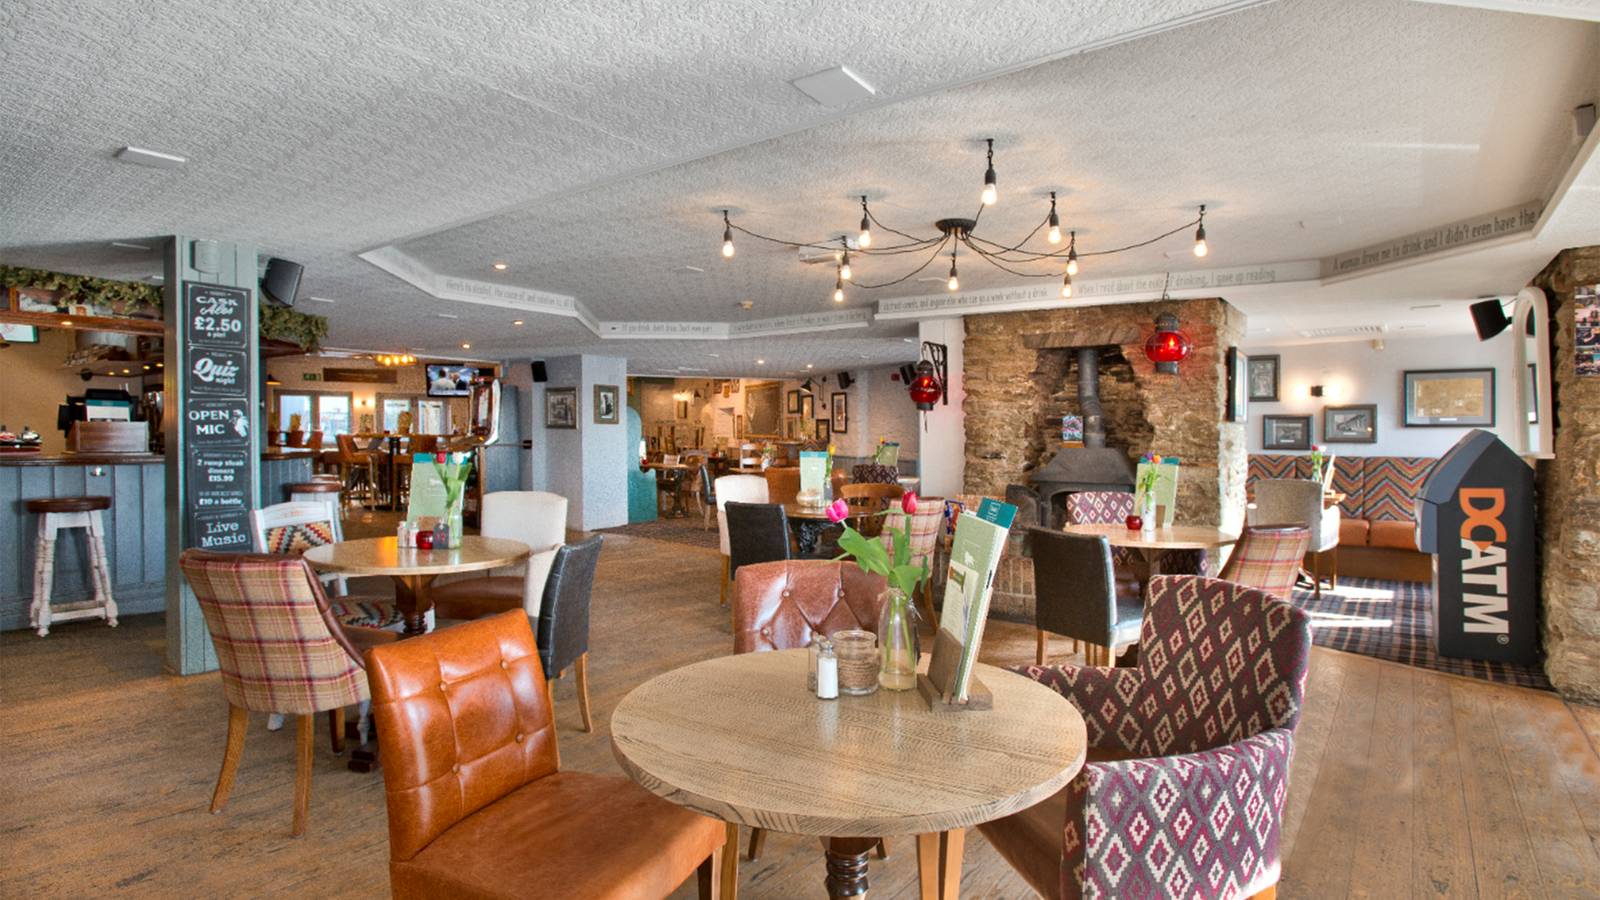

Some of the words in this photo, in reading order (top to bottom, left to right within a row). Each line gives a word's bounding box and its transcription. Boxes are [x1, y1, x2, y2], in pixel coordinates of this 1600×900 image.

[1402, 236, 1422, 255] drink
[1423, 231, 1438, 250] and
[1446, 223, 1470, 245] didn't
[1472, 223, 1492, 238] even
[1494, 215, 1517, 232] have
[1520, 207, 1537, 225] the
[195, 295, 239, 307] CASK
[199, 301, 234, 316] Ales
[194, 316, 242, 332] £2.50
[192, 357, 240, 382] Quiz
[188, 409, 230, 421] OPEN
[195, 423, 226, 436] MIC
[206, 521, 239, 533] Live
[201, 532, 246, 547] Music
